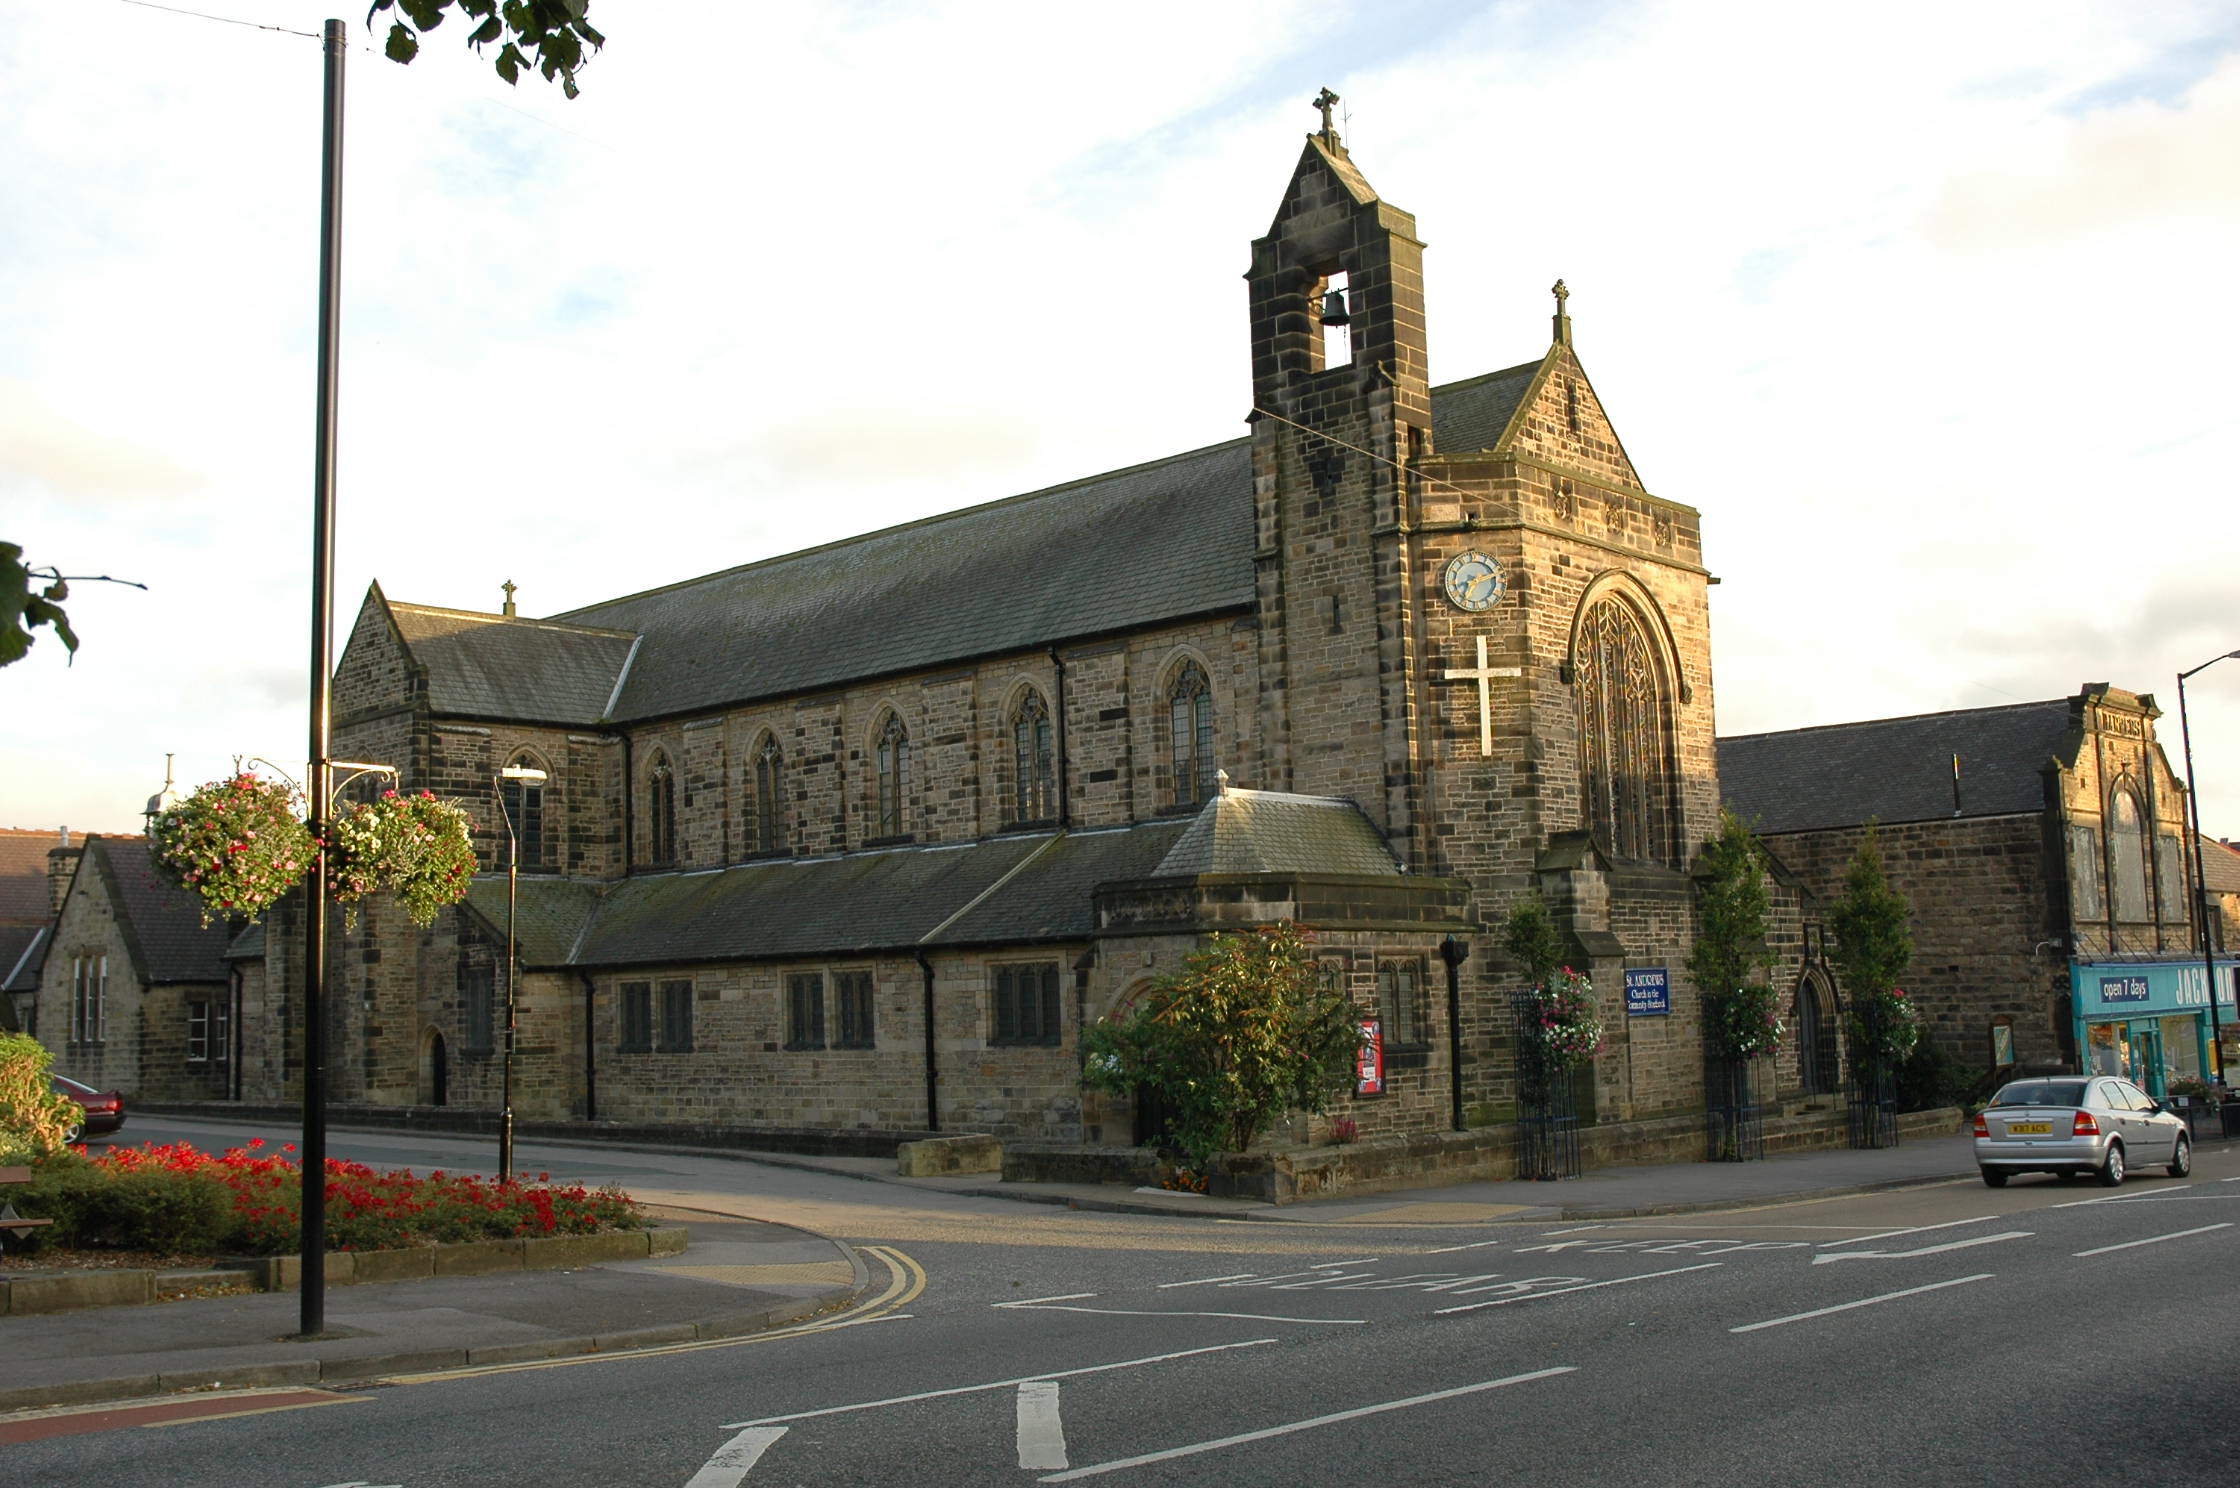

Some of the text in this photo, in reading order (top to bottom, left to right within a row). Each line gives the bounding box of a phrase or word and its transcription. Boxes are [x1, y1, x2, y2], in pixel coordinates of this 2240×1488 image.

[1635, 974, 1664, 987] ANDREWS
[2104, 978, 2146, 1000] open 7 days
[2176, 966, 2234, 1005] JACKON
[1631, 989, 1647, 999] Church
[1512, 1239, 1811, 1256] KEEP
[1217, 1270, 1590, 1295] CLEAR
